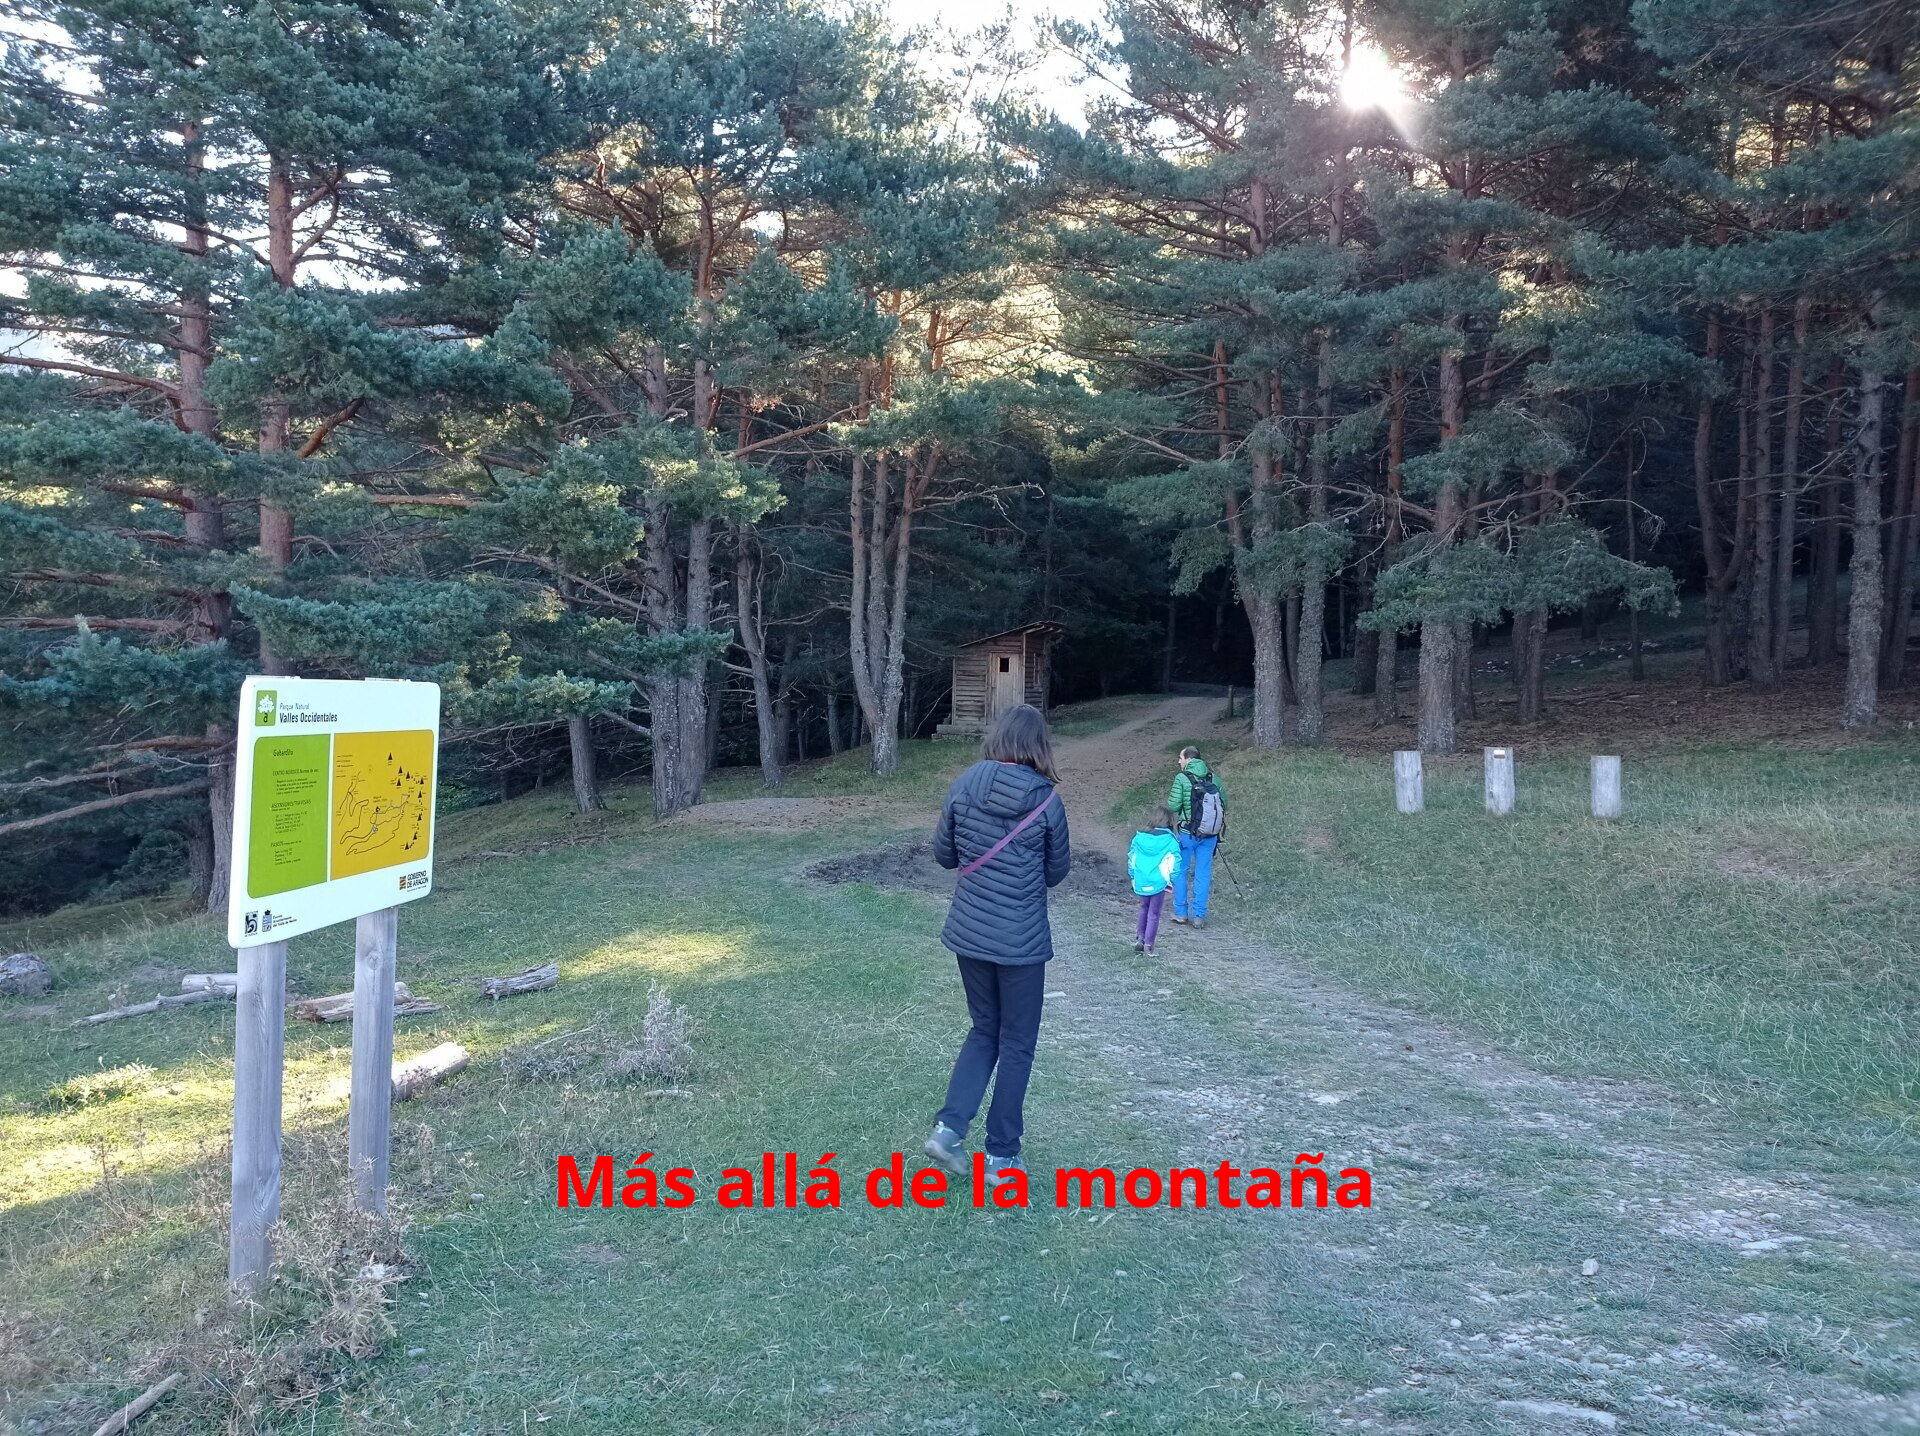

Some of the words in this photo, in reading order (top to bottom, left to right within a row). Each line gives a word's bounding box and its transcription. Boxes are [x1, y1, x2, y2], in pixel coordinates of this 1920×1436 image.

[279, 702, 293, 711] Parque
[295, 702, 310, 710] Natural
[279, 712, 299, 723] Valles
[300, 711, 338, 722] Occidentales
[407, 870, 427, 881] GOBIERNO
[406, 880, 413, 889] DE
